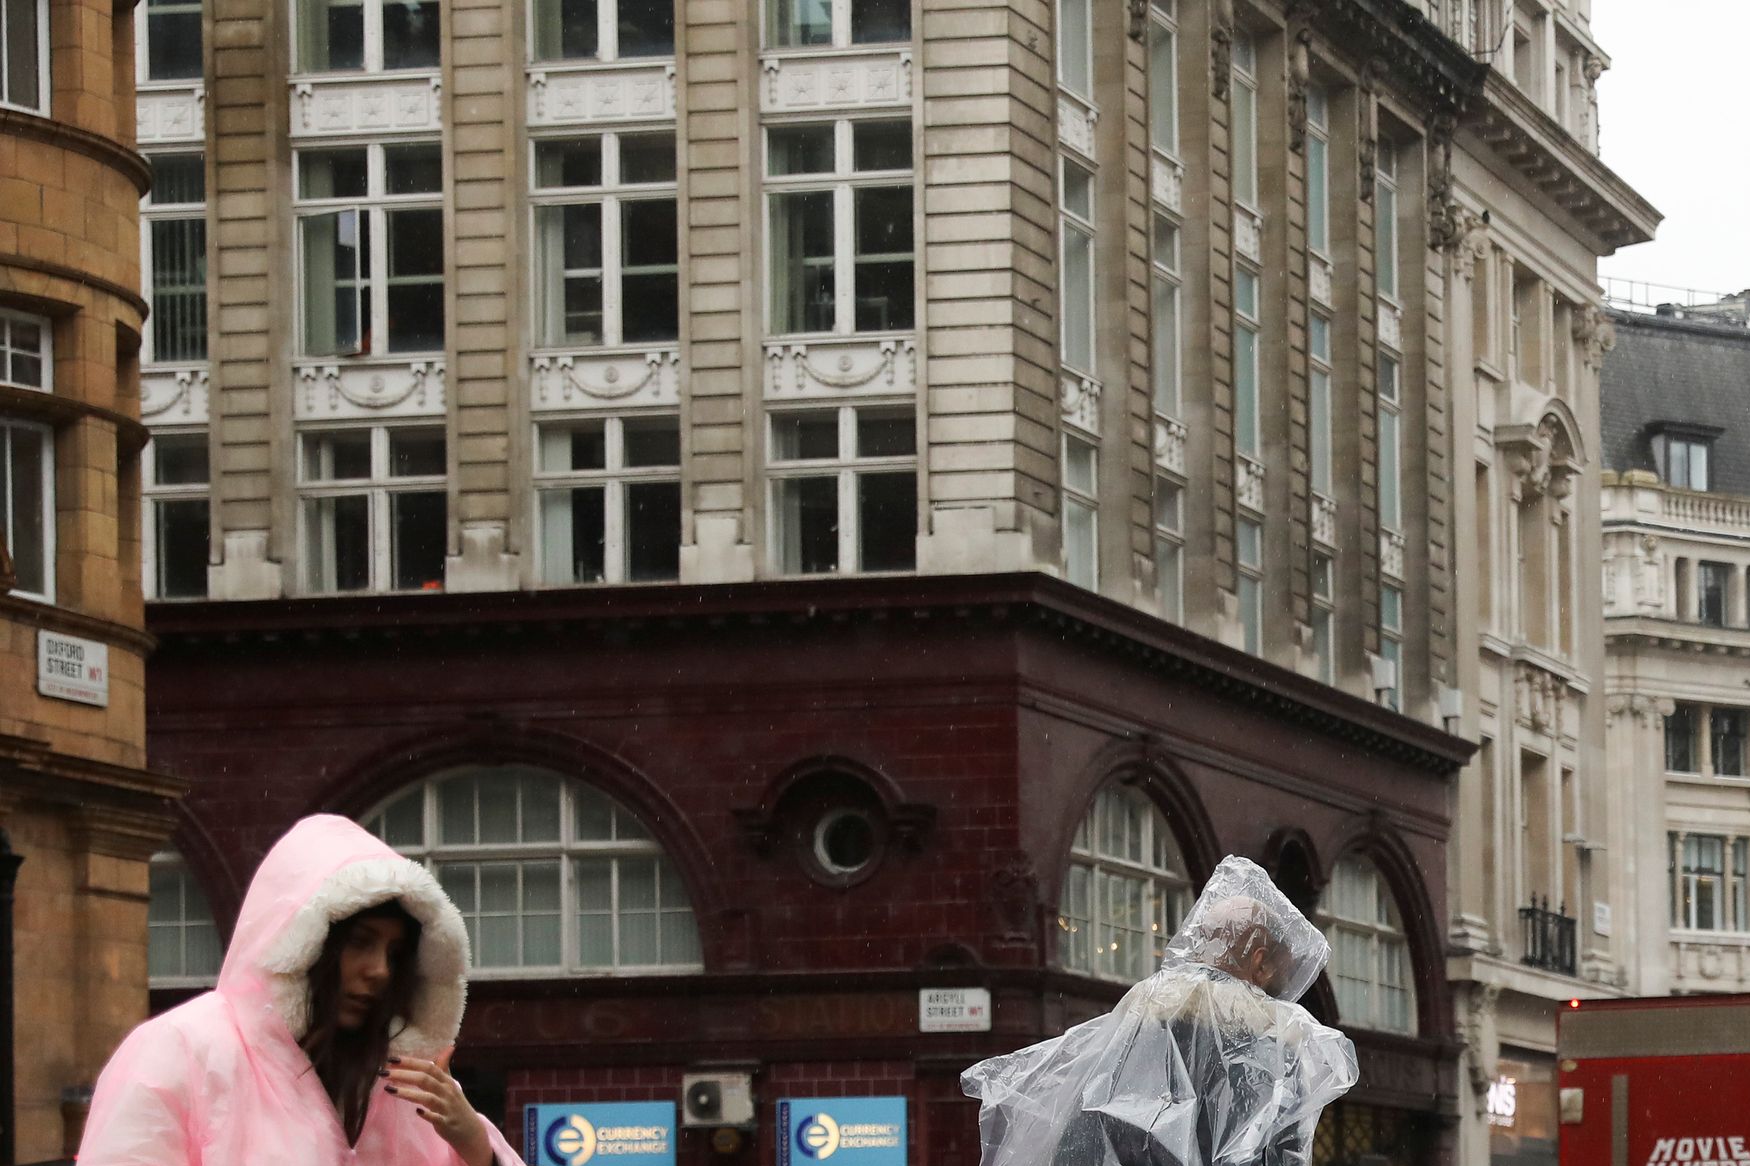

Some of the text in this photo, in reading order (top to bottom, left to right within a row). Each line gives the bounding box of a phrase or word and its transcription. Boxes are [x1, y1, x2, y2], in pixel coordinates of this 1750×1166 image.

[47, 638, 84, 661] OXFORD
[47, 657, 82, 679] STREET
[927, 1007, 964, 1018] STREET
[597, 1126, 669, 1141] CURRENCY
[840, 1124, 900, 1136] CURRENCY
[597, 1141, 668, 1155] EXCHANGE
[840, 1136, 899, 1148] EXCHANGE
